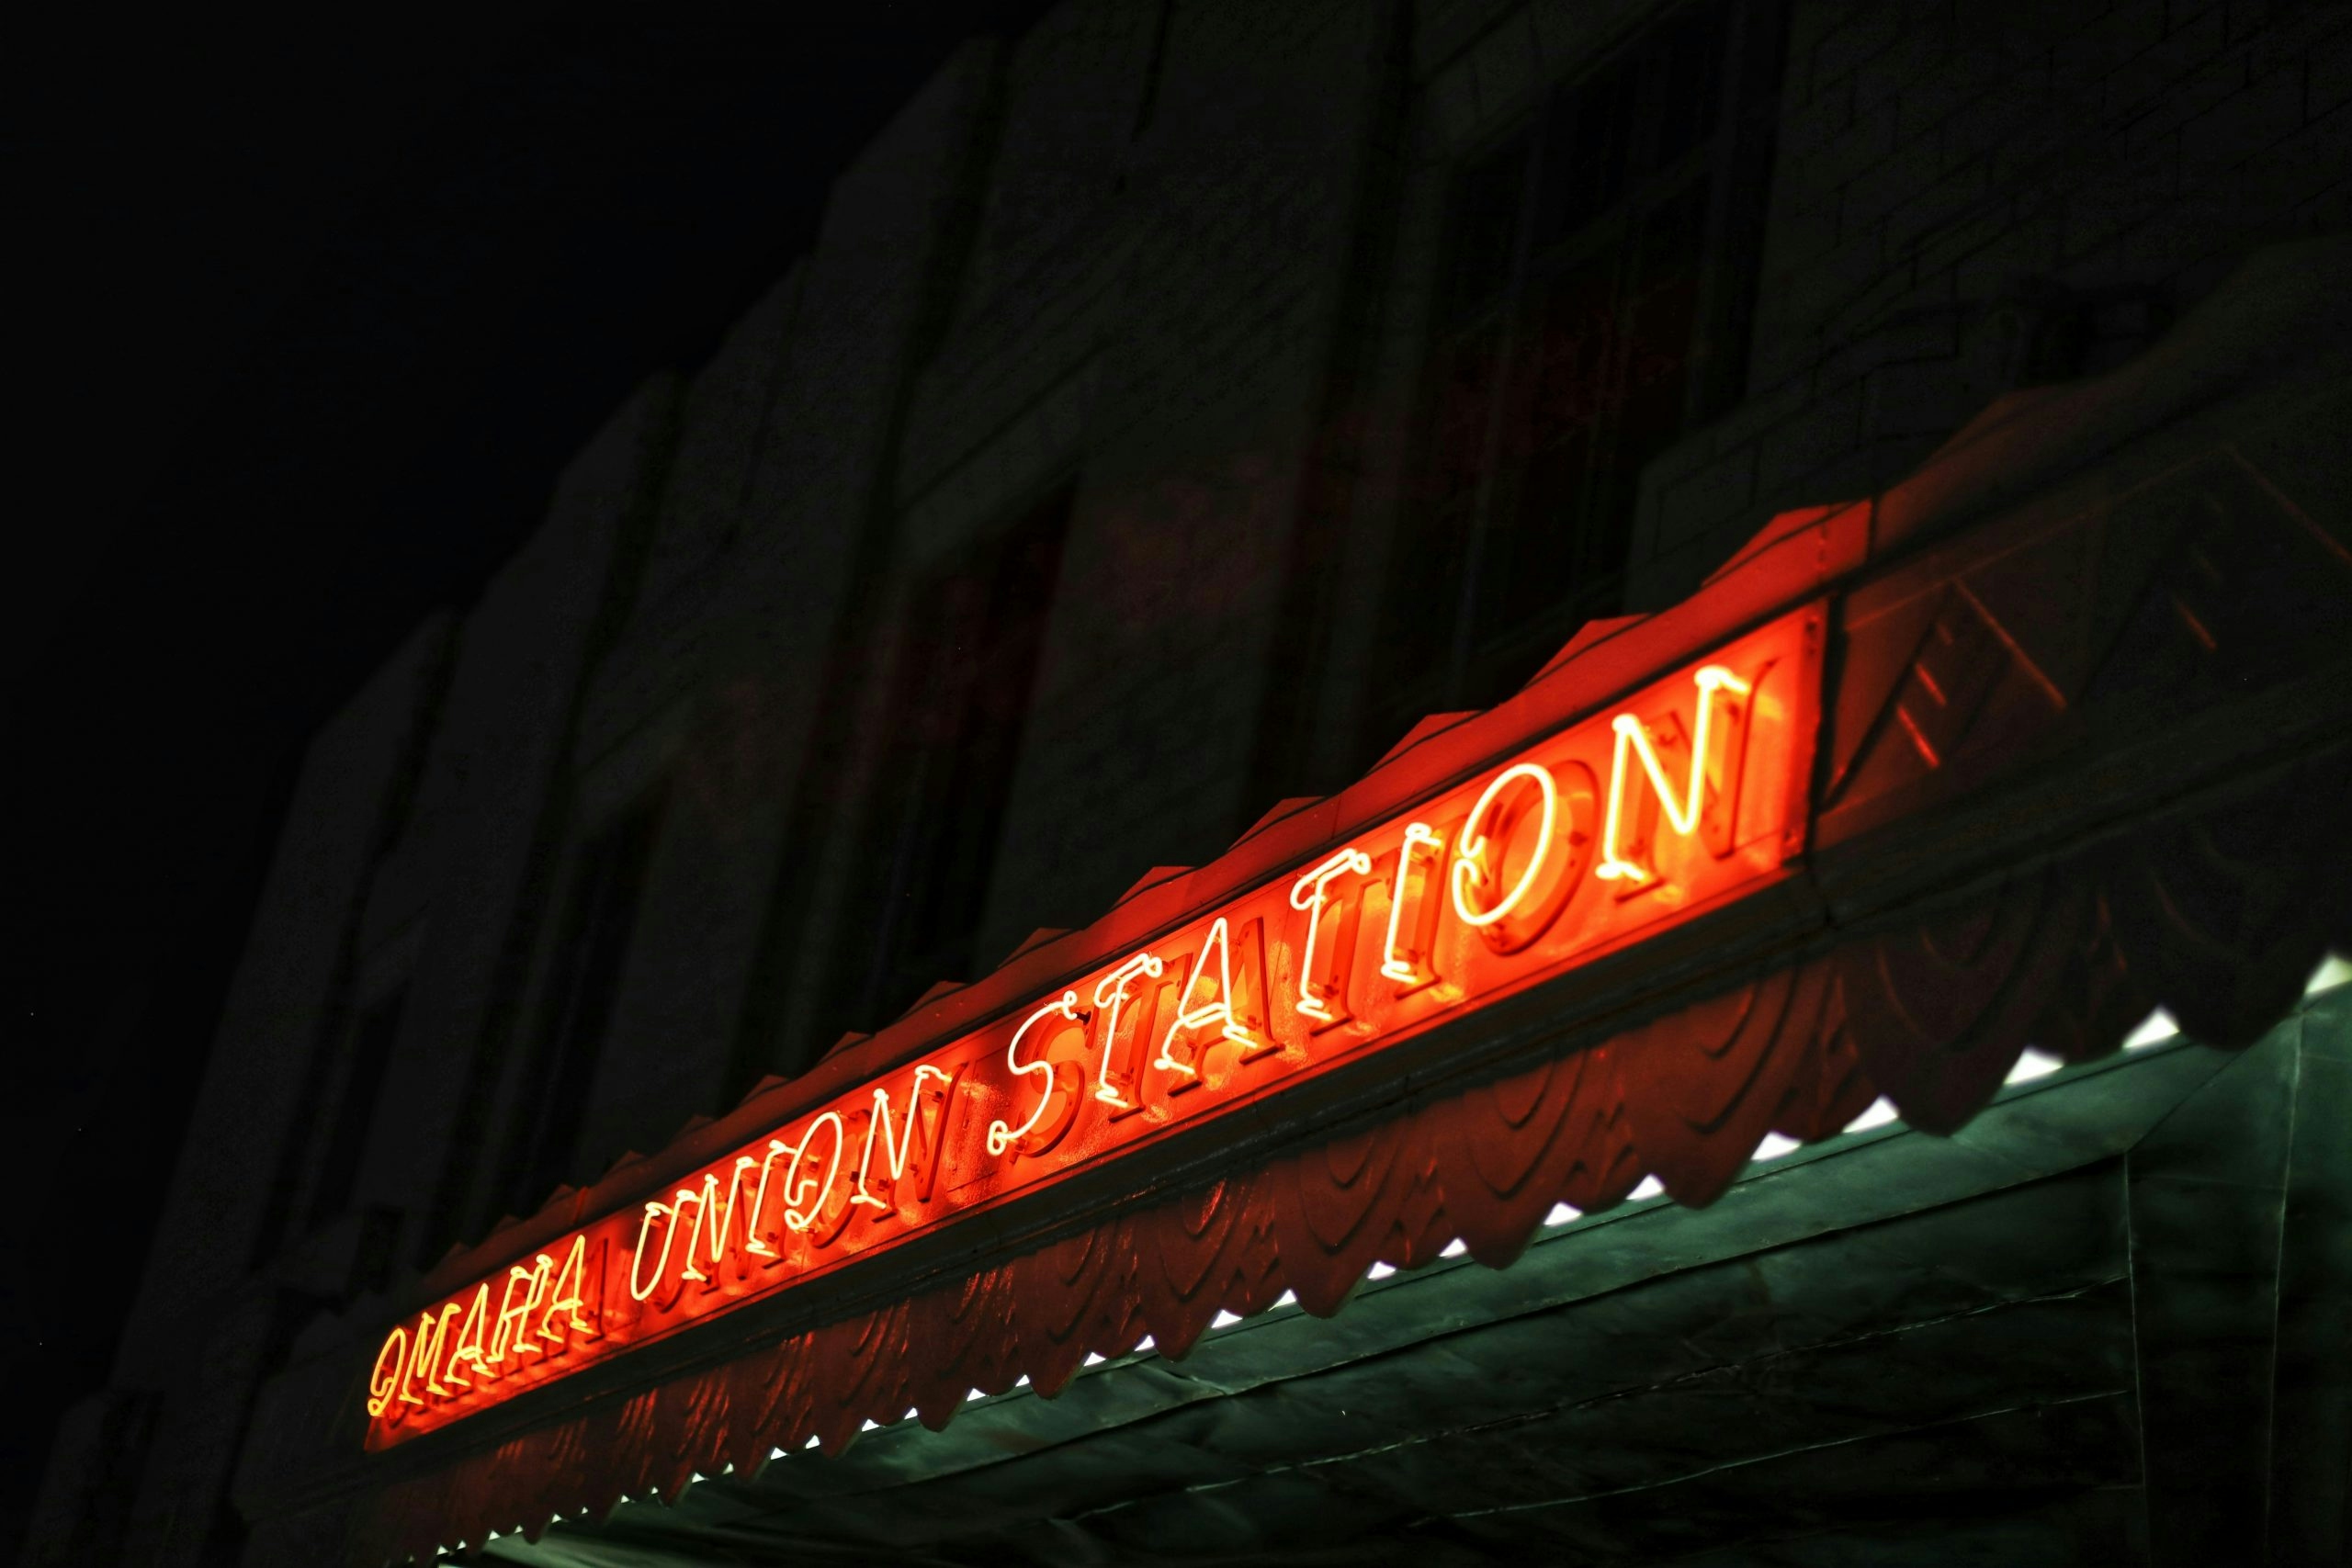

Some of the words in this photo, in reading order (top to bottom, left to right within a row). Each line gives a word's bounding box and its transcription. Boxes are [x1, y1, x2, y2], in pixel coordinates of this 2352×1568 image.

[368, 1235, 599, 1417] OMAHA
[630, 1065, 954, 1301] UNION
[988, 665, 1753, 1156] STATION
